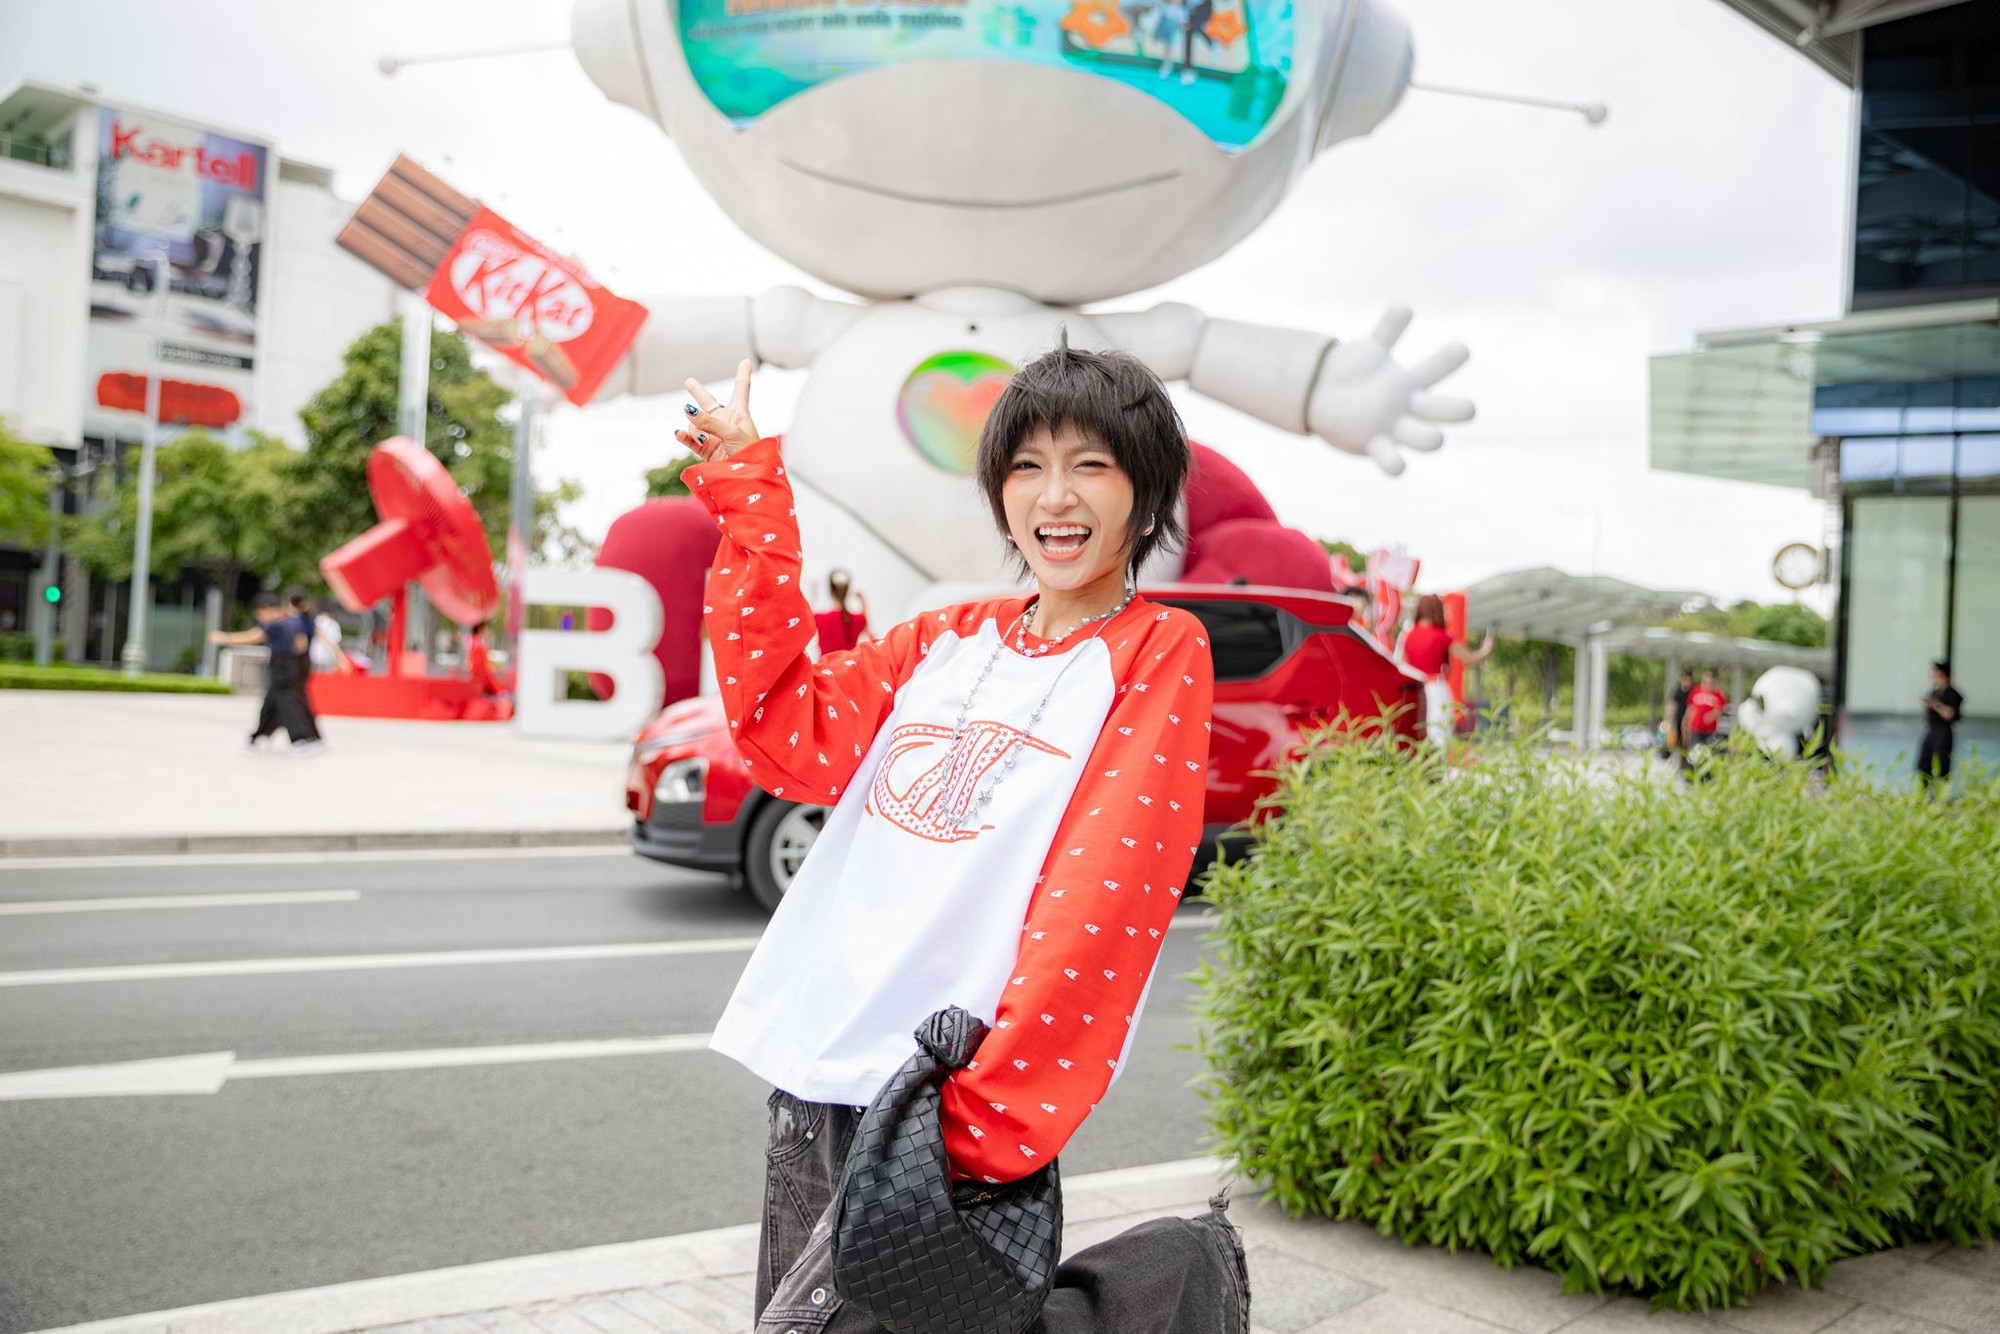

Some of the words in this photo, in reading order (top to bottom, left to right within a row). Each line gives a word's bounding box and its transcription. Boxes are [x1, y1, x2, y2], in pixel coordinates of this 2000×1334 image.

[111, 122, 256, 188] Kartell
[464, 257, 586, 328] KitKat
[517, 567, 666, 744] B
